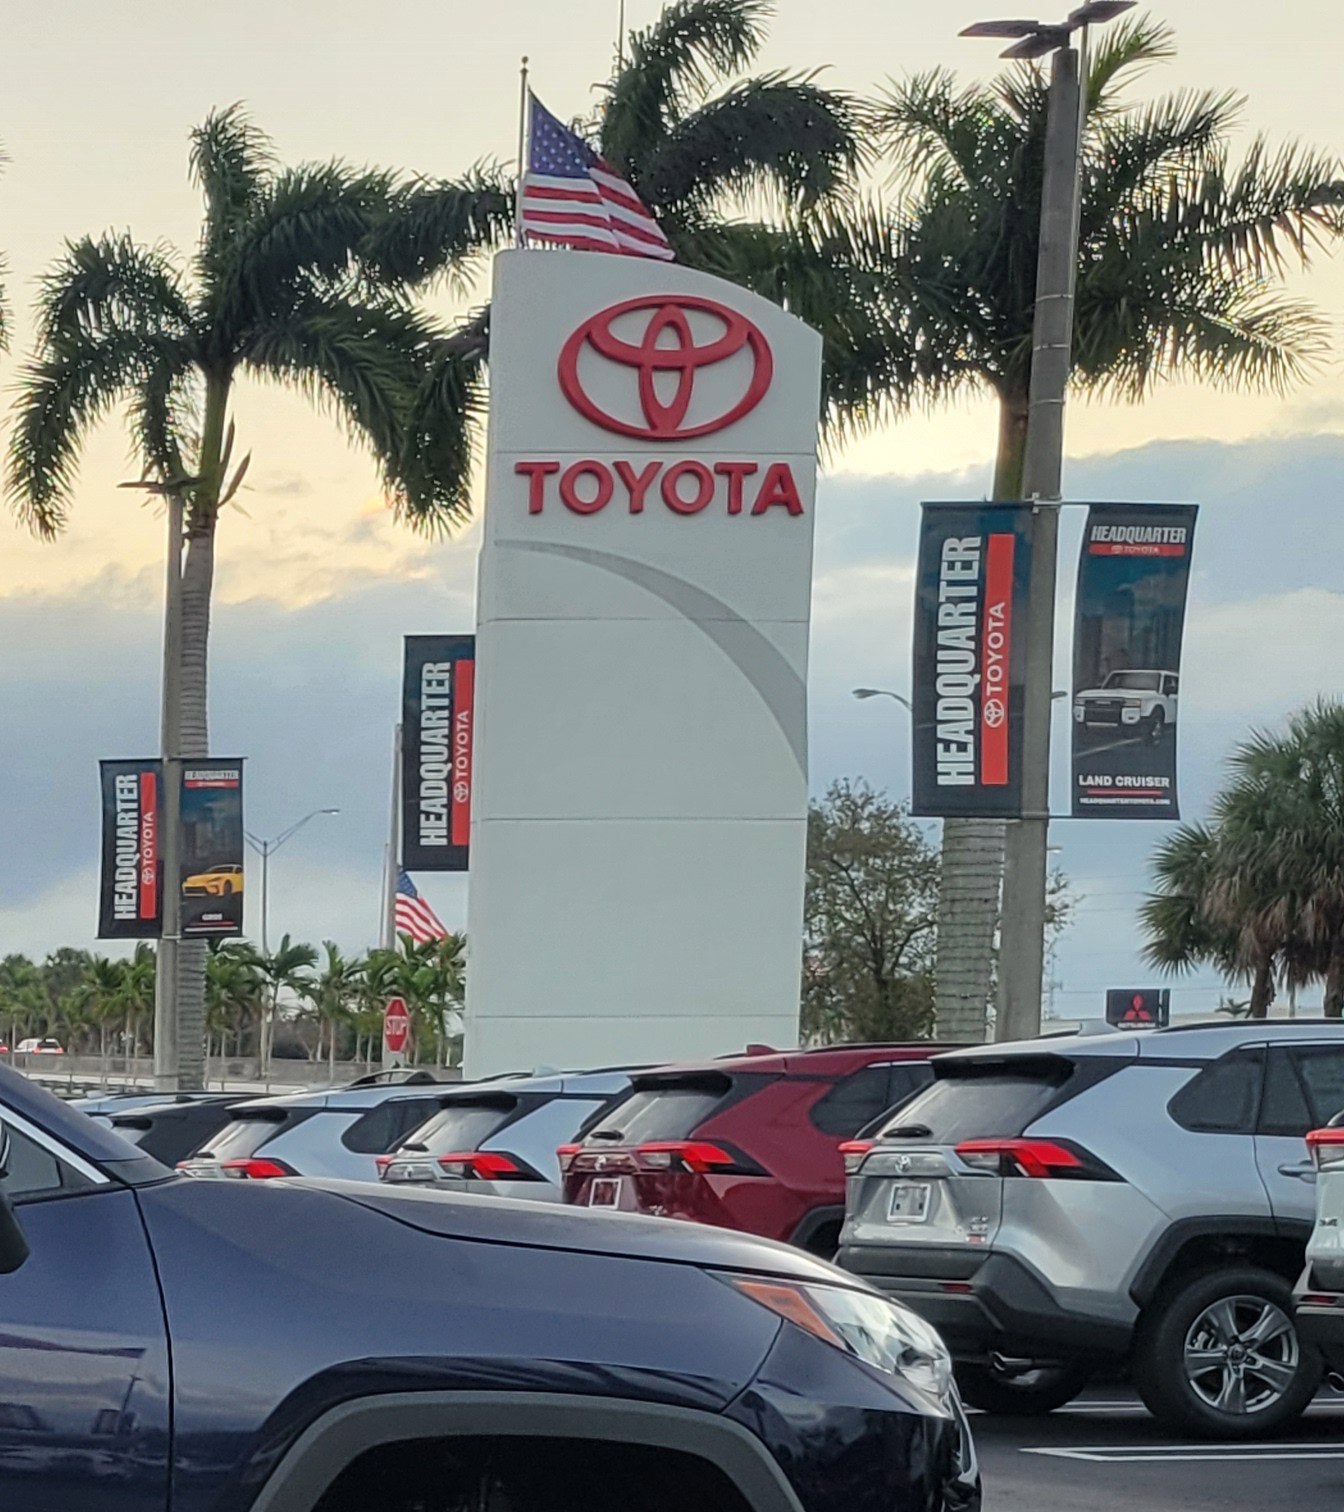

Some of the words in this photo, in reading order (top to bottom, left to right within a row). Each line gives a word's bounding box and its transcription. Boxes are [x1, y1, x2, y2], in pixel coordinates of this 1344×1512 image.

[514, 459, 805, 515] TOYOTA
[1091, 525, 1187, 545] HEADQUARTER
[936, 535, 982, 786] HEADQUARTER
[985, 601, 1006, 697] TOYOTA
[419, 661, 453, 847] HEADQUARTER
[455, 709, 470, 779] TOYOTA
[1078, 774, 1113, 787] LAND
[1114, 775, 1170, 788] CRUISER
[113, 773, 141, 921] HEADQUARTER
[141, 811, 155, 867] TOYOTA
